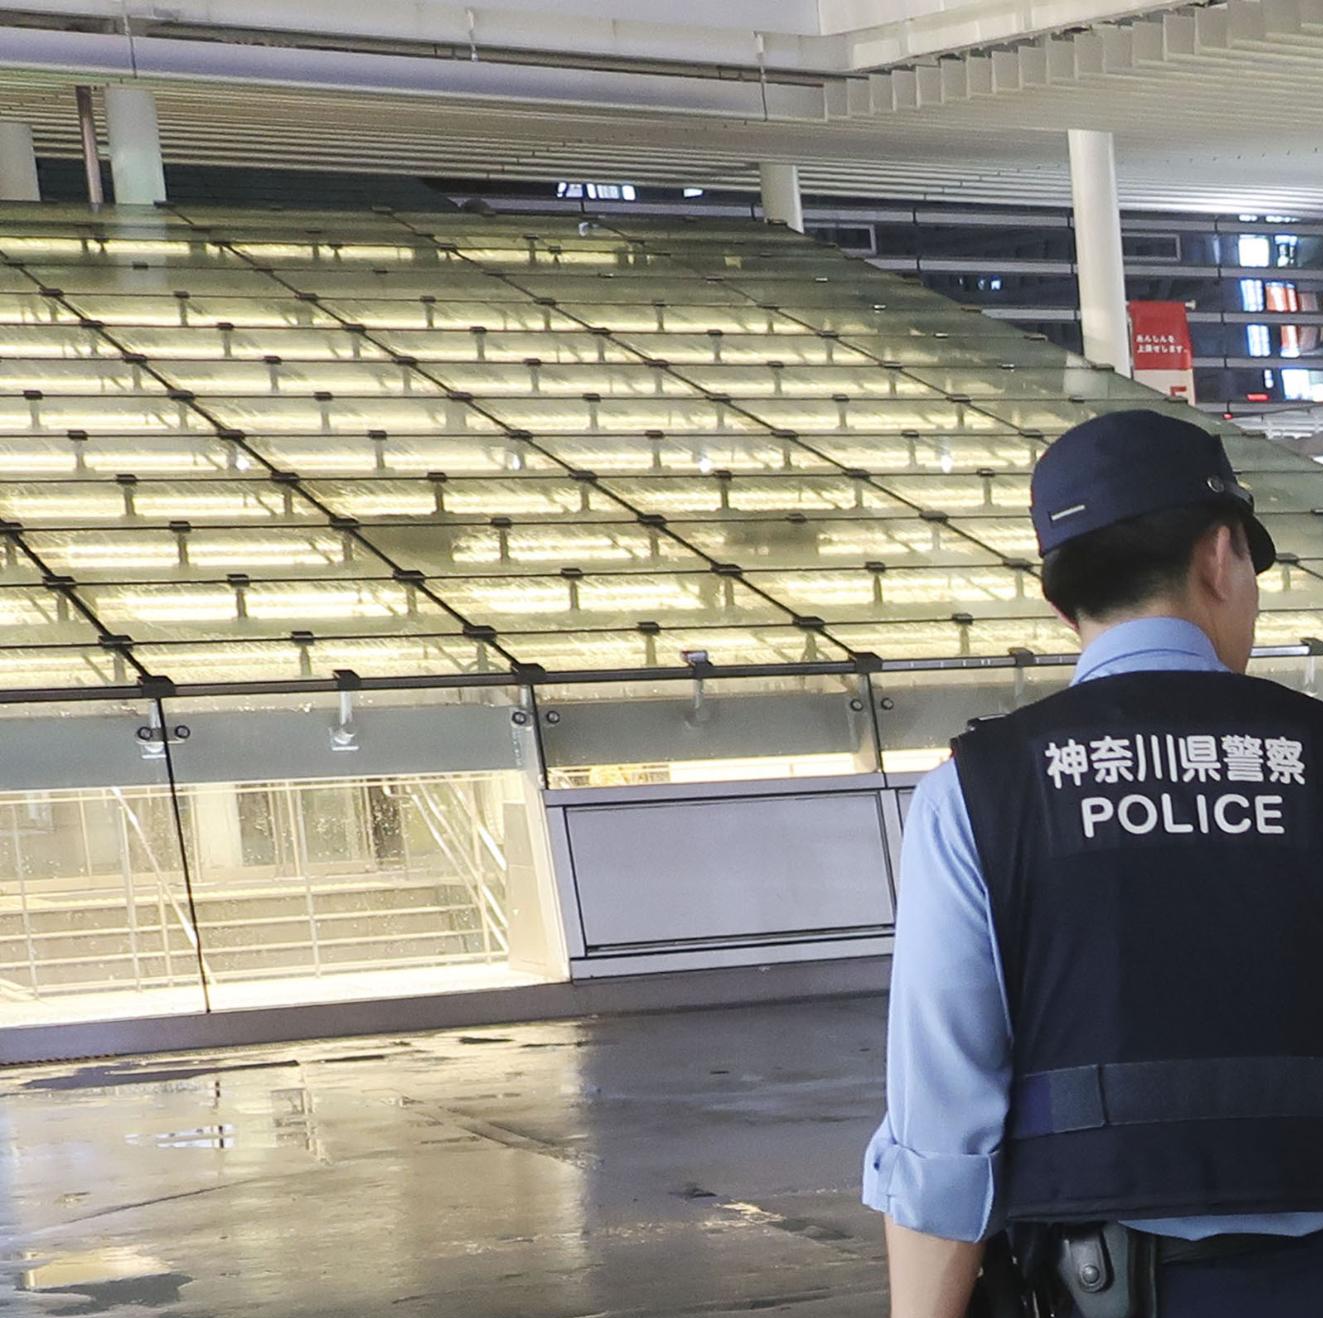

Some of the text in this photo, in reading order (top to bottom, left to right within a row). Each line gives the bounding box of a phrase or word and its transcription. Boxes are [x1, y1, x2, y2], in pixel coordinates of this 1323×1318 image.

[1045, 733, 1306, 789] 神奈川県警察
[1081, 793, 1286, 838] POLICE
